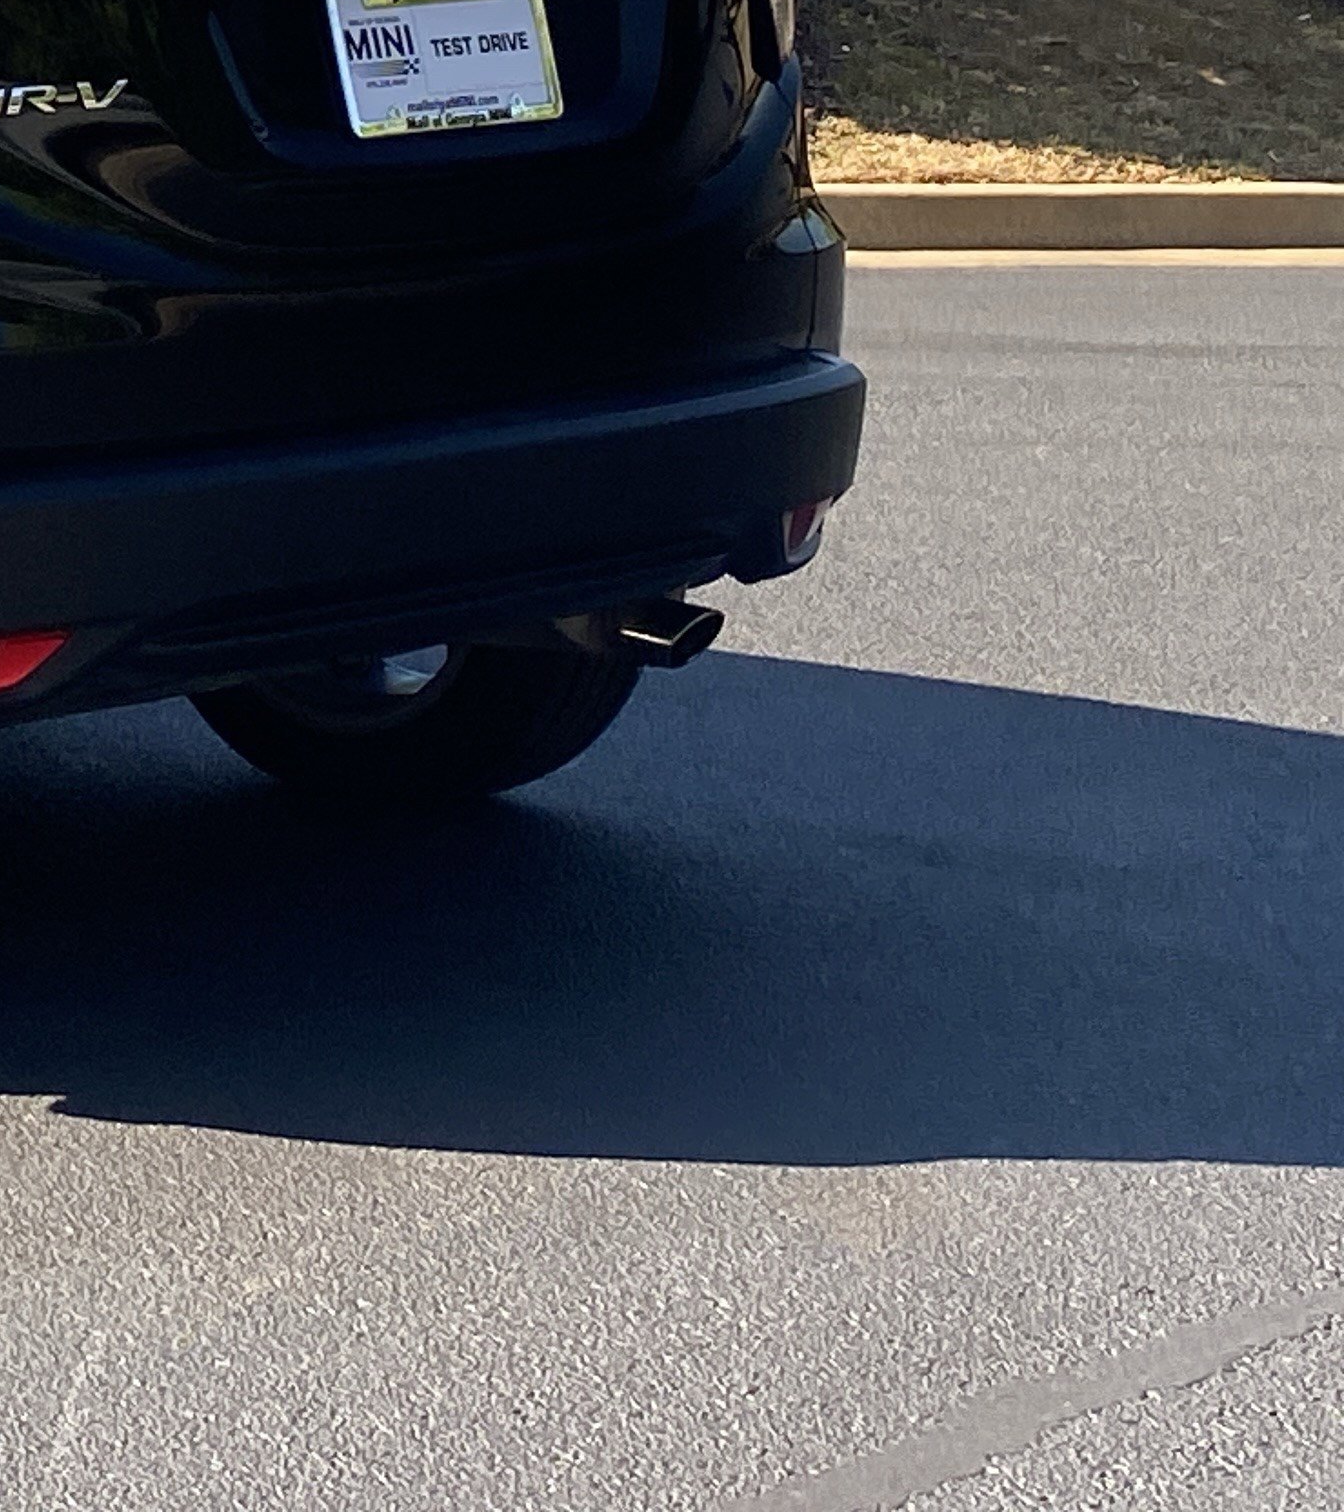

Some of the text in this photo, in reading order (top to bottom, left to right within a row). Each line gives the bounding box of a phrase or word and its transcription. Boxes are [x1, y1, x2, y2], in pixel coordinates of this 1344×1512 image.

[343, 24, 415, 62] MINI
[430, 31, 529, 57] TEST DRIVE
